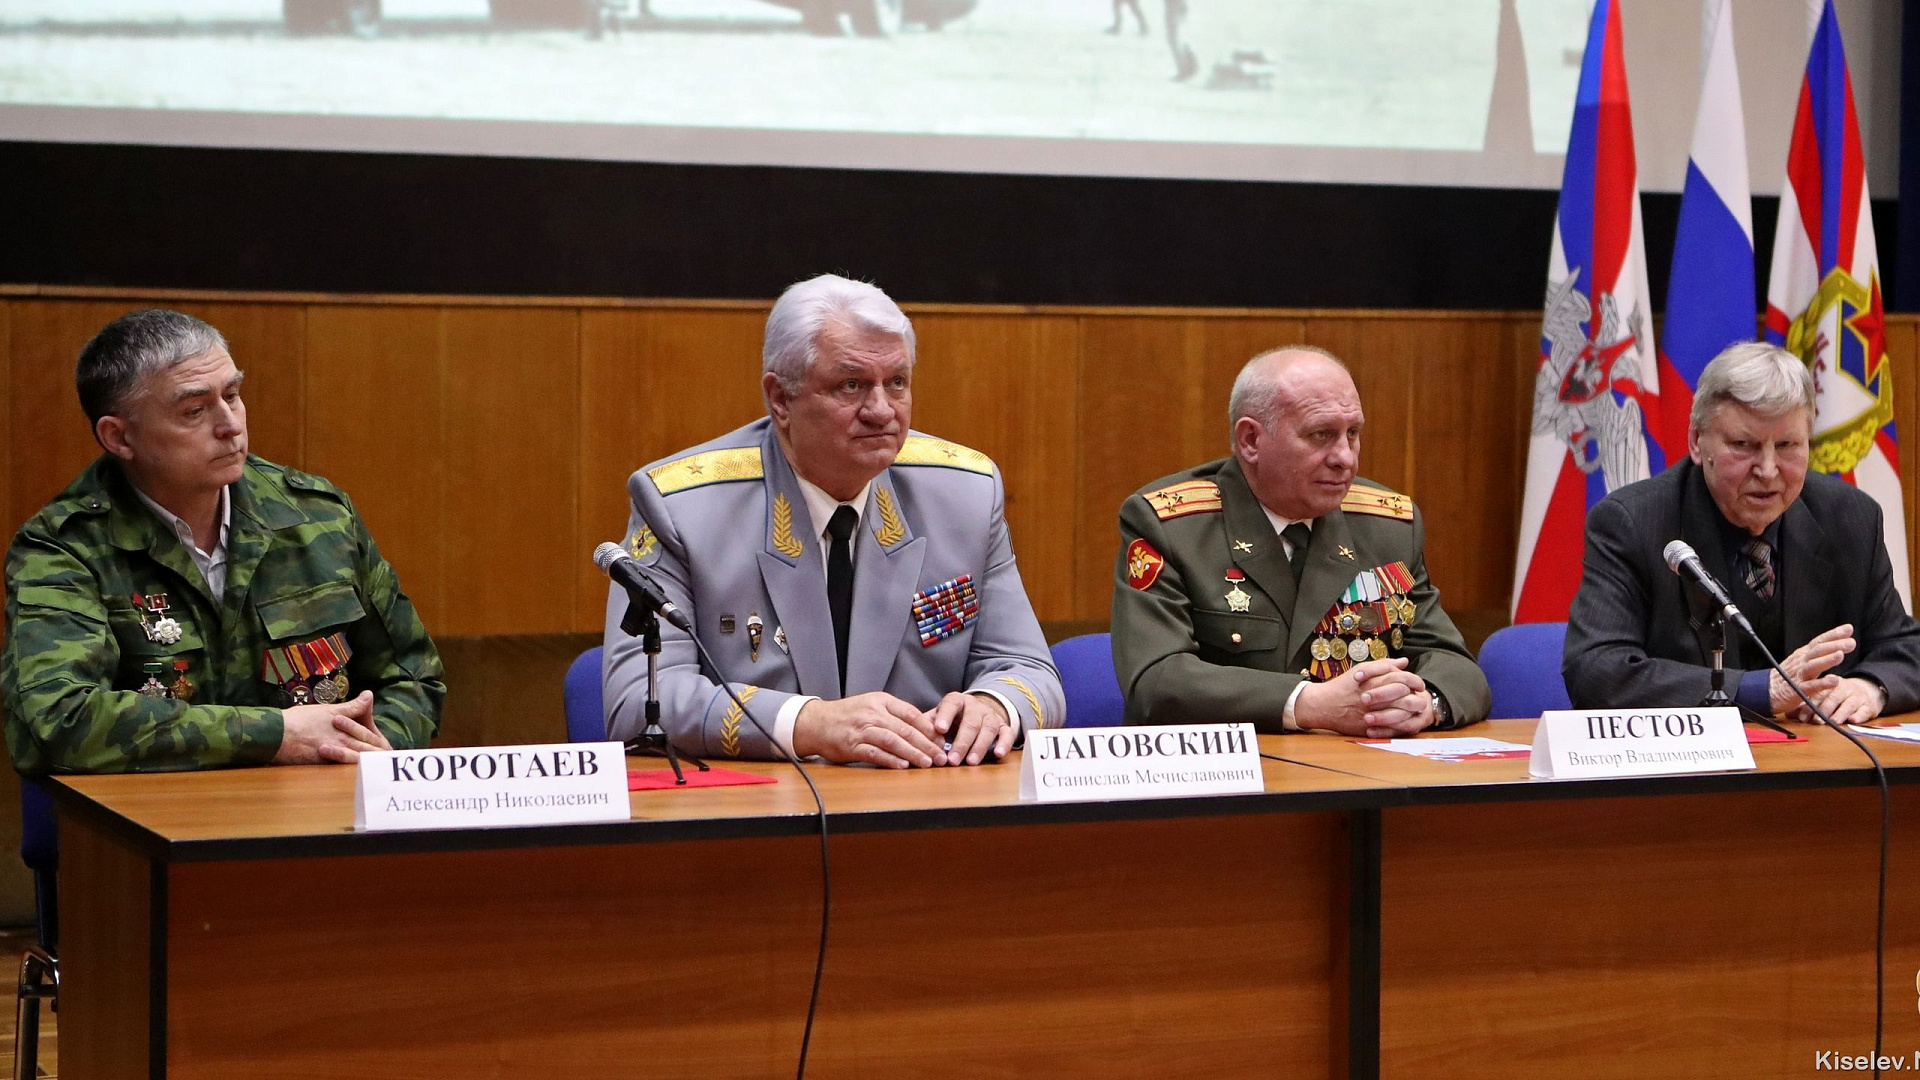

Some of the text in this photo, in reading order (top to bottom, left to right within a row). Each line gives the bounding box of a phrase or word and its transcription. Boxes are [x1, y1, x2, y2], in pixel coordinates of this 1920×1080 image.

[1586, 713, 1705, 739] ПЕСТОВ
[1040, 722, 1249, 760] ЛАГОВСКИЙ
[391, 750, 599, 782] КОРОТАЕВ
[1568, 747, 1735, 767] Виктор Владимирович
[1042, 768, 1256, 788] Станислав Мечиславович
[386, 791, 610, 813] Александр Николаевич
